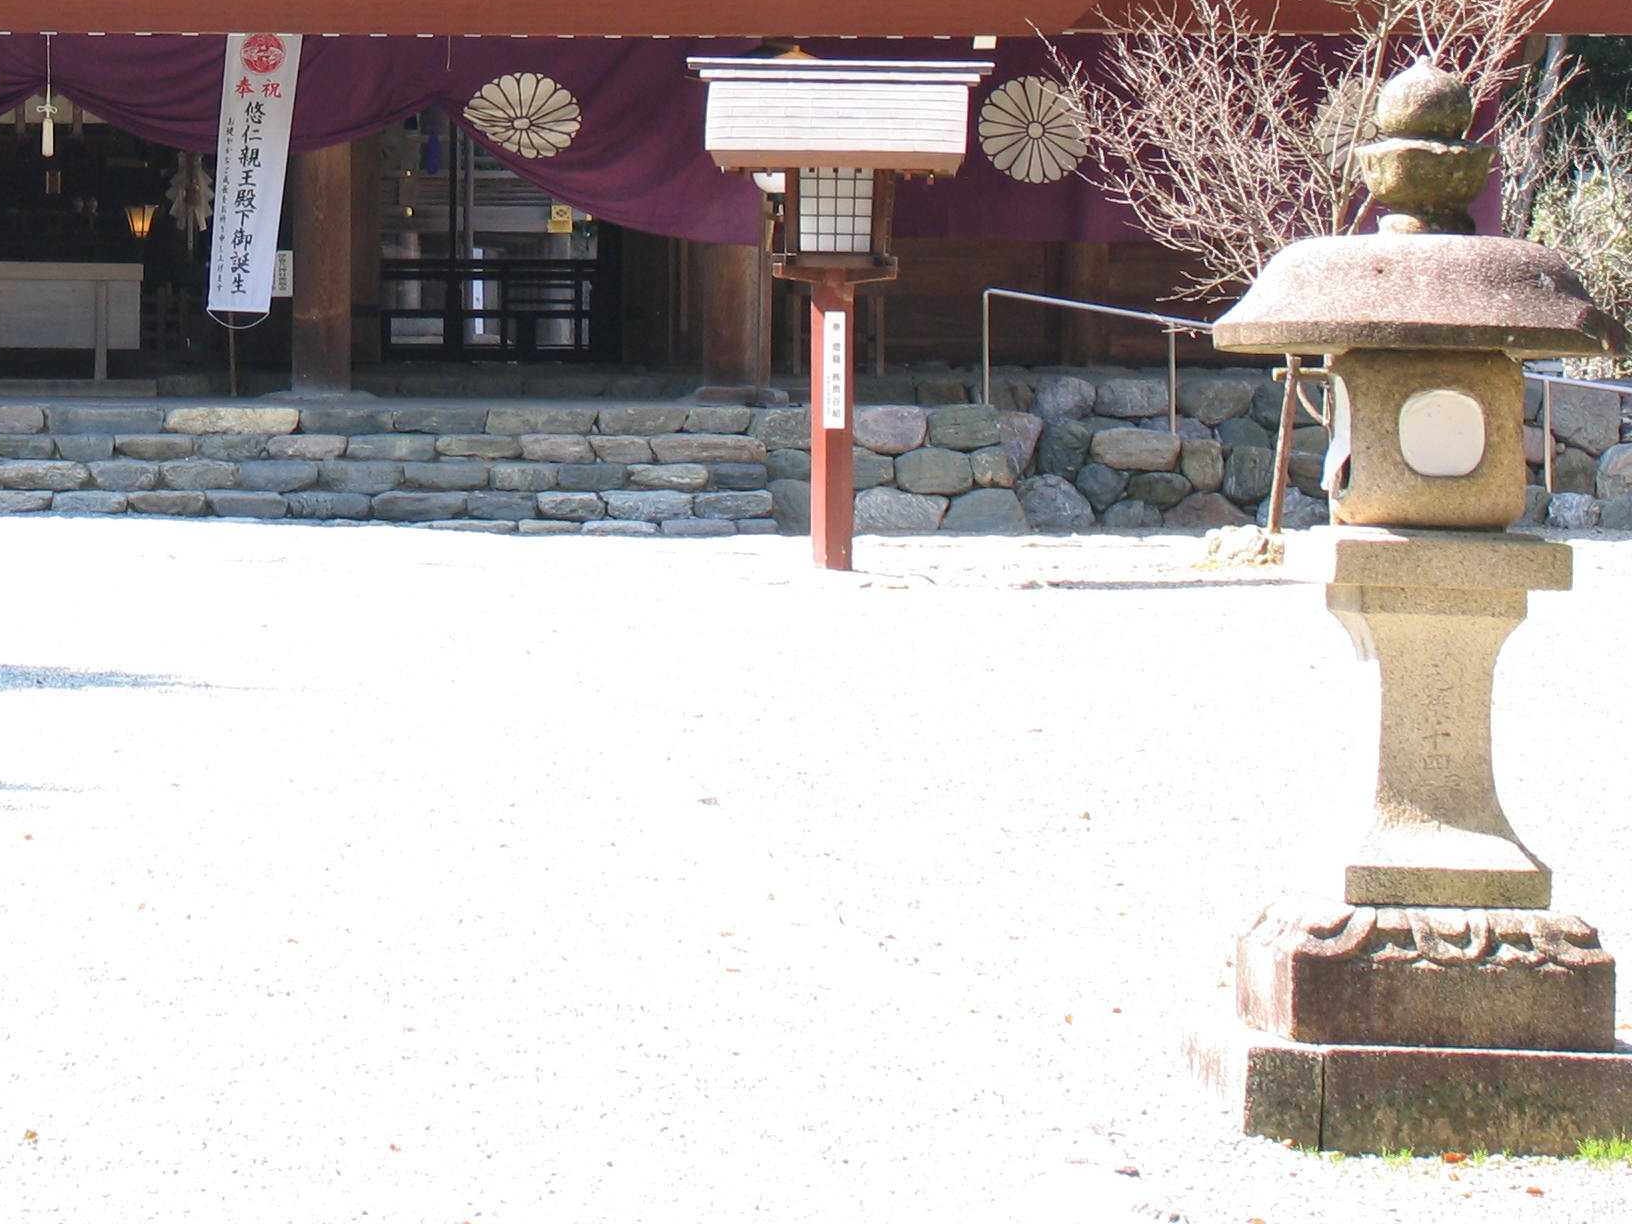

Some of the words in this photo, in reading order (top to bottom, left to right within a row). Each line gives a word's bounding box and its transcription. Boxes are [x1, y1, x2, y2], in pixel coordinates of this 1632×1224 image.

[235, 76, 282, 98] 奉祝
[230, 101, 266, 294] 悠仁親王殿下御誕生
